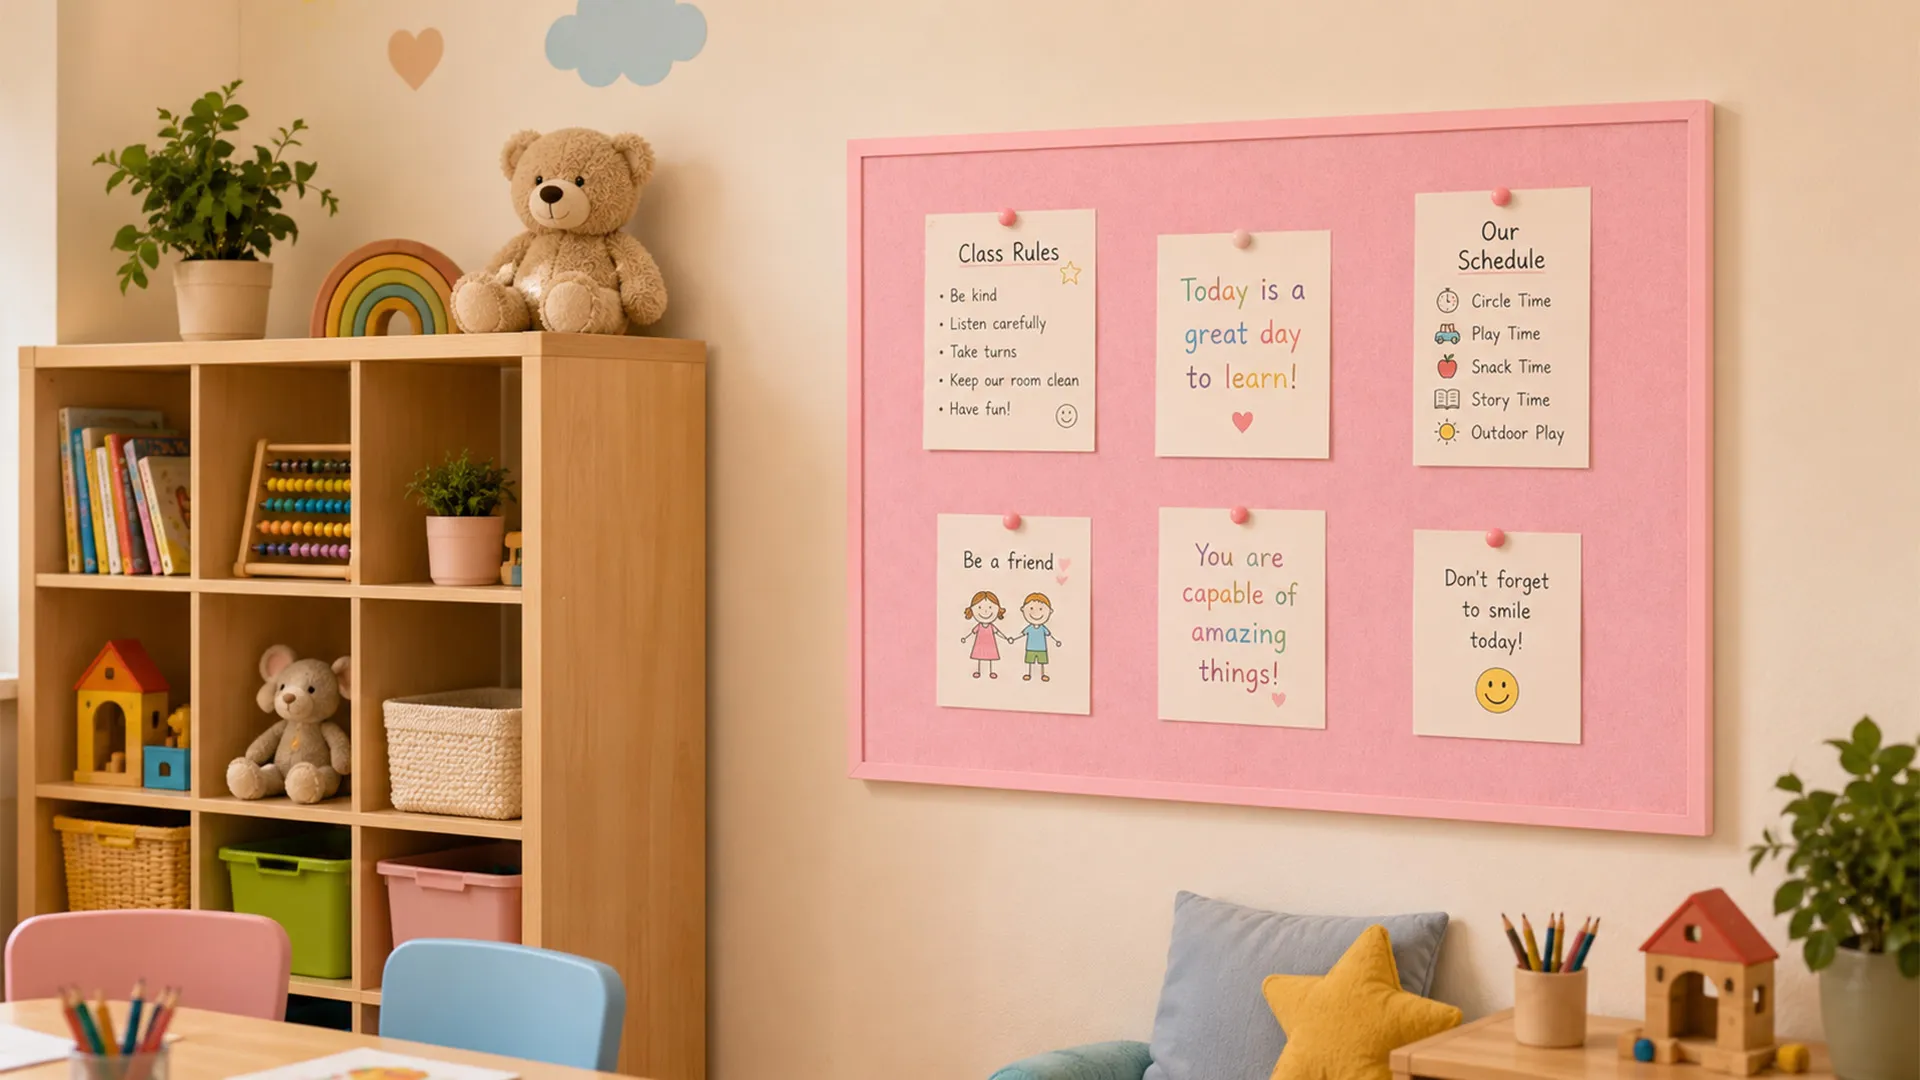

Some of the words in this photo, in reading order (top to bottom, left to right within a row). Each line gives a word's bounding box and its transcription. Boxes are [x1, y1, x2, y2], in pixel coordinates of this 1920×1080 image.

[1481, 220, 1520, 242] Our
[958, 242, 1004, 264] Class
[1013, 240, 1060, 262] Rules
[1458, 247, 1546, 271] Schedule
[950, 287, 966, 303] Be
[971, 287, 997, 302] kind
[1180, 275, 1248, 310] Today
[1261, 278, 1279, 301] is
[1291, 284, 1306, 300] a
[1471, 292, 1511, 309] Circle
[1517, 292, 1552, 308] Time
[950, 317, 987, 331] Listen
[992, 314, 1047, 335] carefully
[1472, 325, 1501, 346] Play
[1507, 325, 1541, 341] Time
[1184, 321, 1248, 355] great
[1260, 319, 1301, 354] day
[950, 343, 978, 359] Take
[983, 345, 1017, 359] turns
[1186, 365, 1212, 389] to
[1226, 363, 1296, 390] learn!
[1471, 358, 1512, 375] Snack
[1518, 358, 1552, 375] Time
[950, 372, 979, 391] Keep
[984, 377, 1005, 387] our
[1010, 377, 1041, 387] room
[1046, 372, 1080, 387] clean
[950, 401, 979, 416] Have
[985, 400, 1011, 416] fun!
[1471, 391, 1510, 412] Story
[1516, 391, 1551, 407] Time
[1471, 424, 1529, 440] Outdoor
[1535, 424, 1565, 446] Play
[963, 550, 983, 569] Be
[990, 557, 1000, 569] a
[1007, 550, 1054, 571] friend
[1195, 542, 1234, 567] You
[1246, 552, 1284, 568] are
[1445, 568, 1488, 588] Don't
[1496, 568, 1550, 596] forget
[1182, 580, 1264, 611] capable
[1275, 581, 1298, 607] of
[1461, 600, 1480, 618] to
[1489, 600, 1531, 620] smile
[1191, 622, 1286, 655] amazing
[1469, 630, 1523, 656] today!
[1198, 658, 1278, 694] things!
